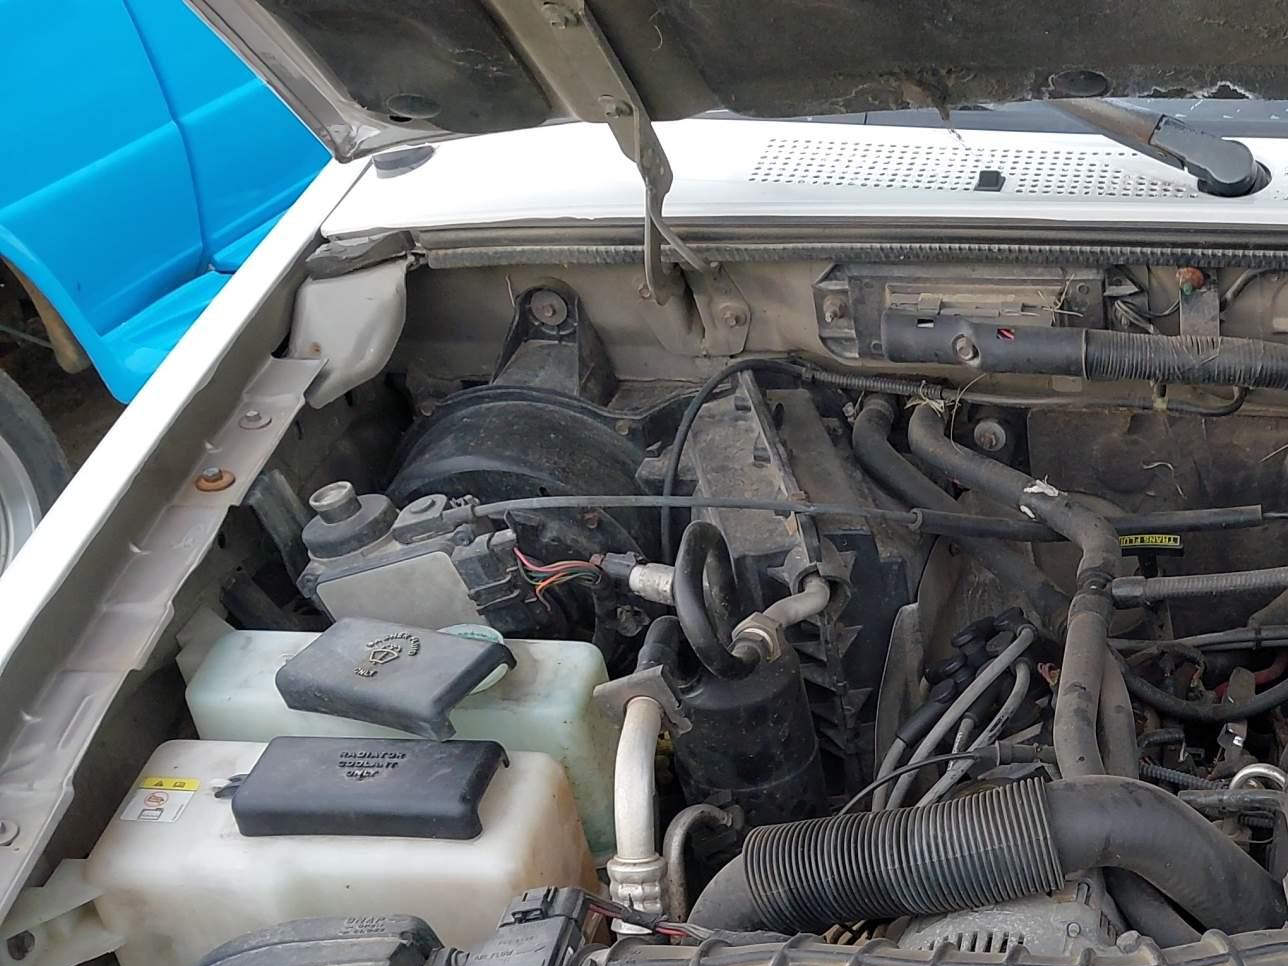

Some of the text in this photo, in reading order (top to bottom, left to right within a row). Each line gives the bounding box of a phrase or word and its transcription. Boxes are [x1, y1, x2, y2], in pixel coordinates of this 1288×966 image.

[340, 751, 406, 759] RADIATOR
[338, 760, 399, 768] COOLANT
[346, 770, 379, 778] ONLY
